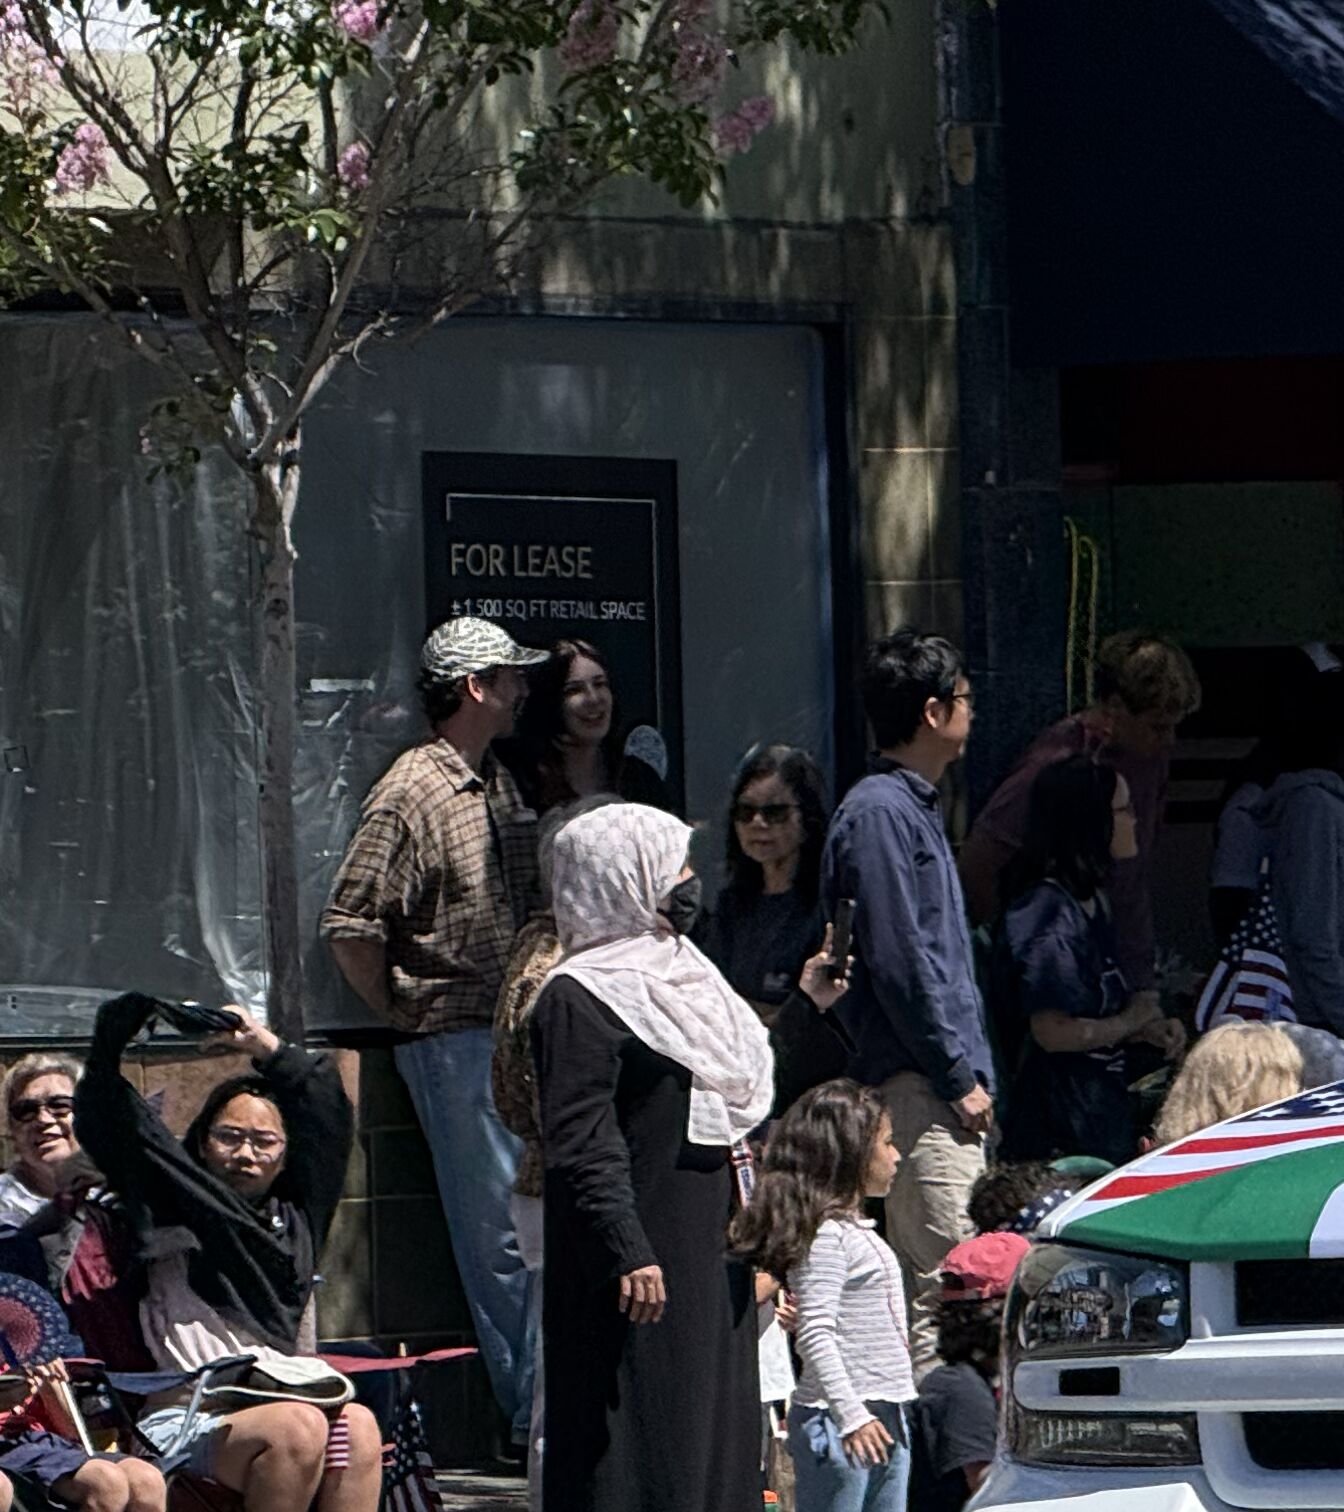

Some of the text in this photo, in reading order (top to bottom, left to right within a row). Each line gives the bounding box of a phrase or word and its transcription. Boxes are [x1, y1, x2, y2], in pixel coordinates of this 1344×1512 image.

[450, 543, 594, 580] FOR LEASE
[505, 600, 528, 622] SQ
[530, 600, 547, 619] FT
[551, 600, 599, 621] RETAIL
[600, 601, 647, 622] SPACE
